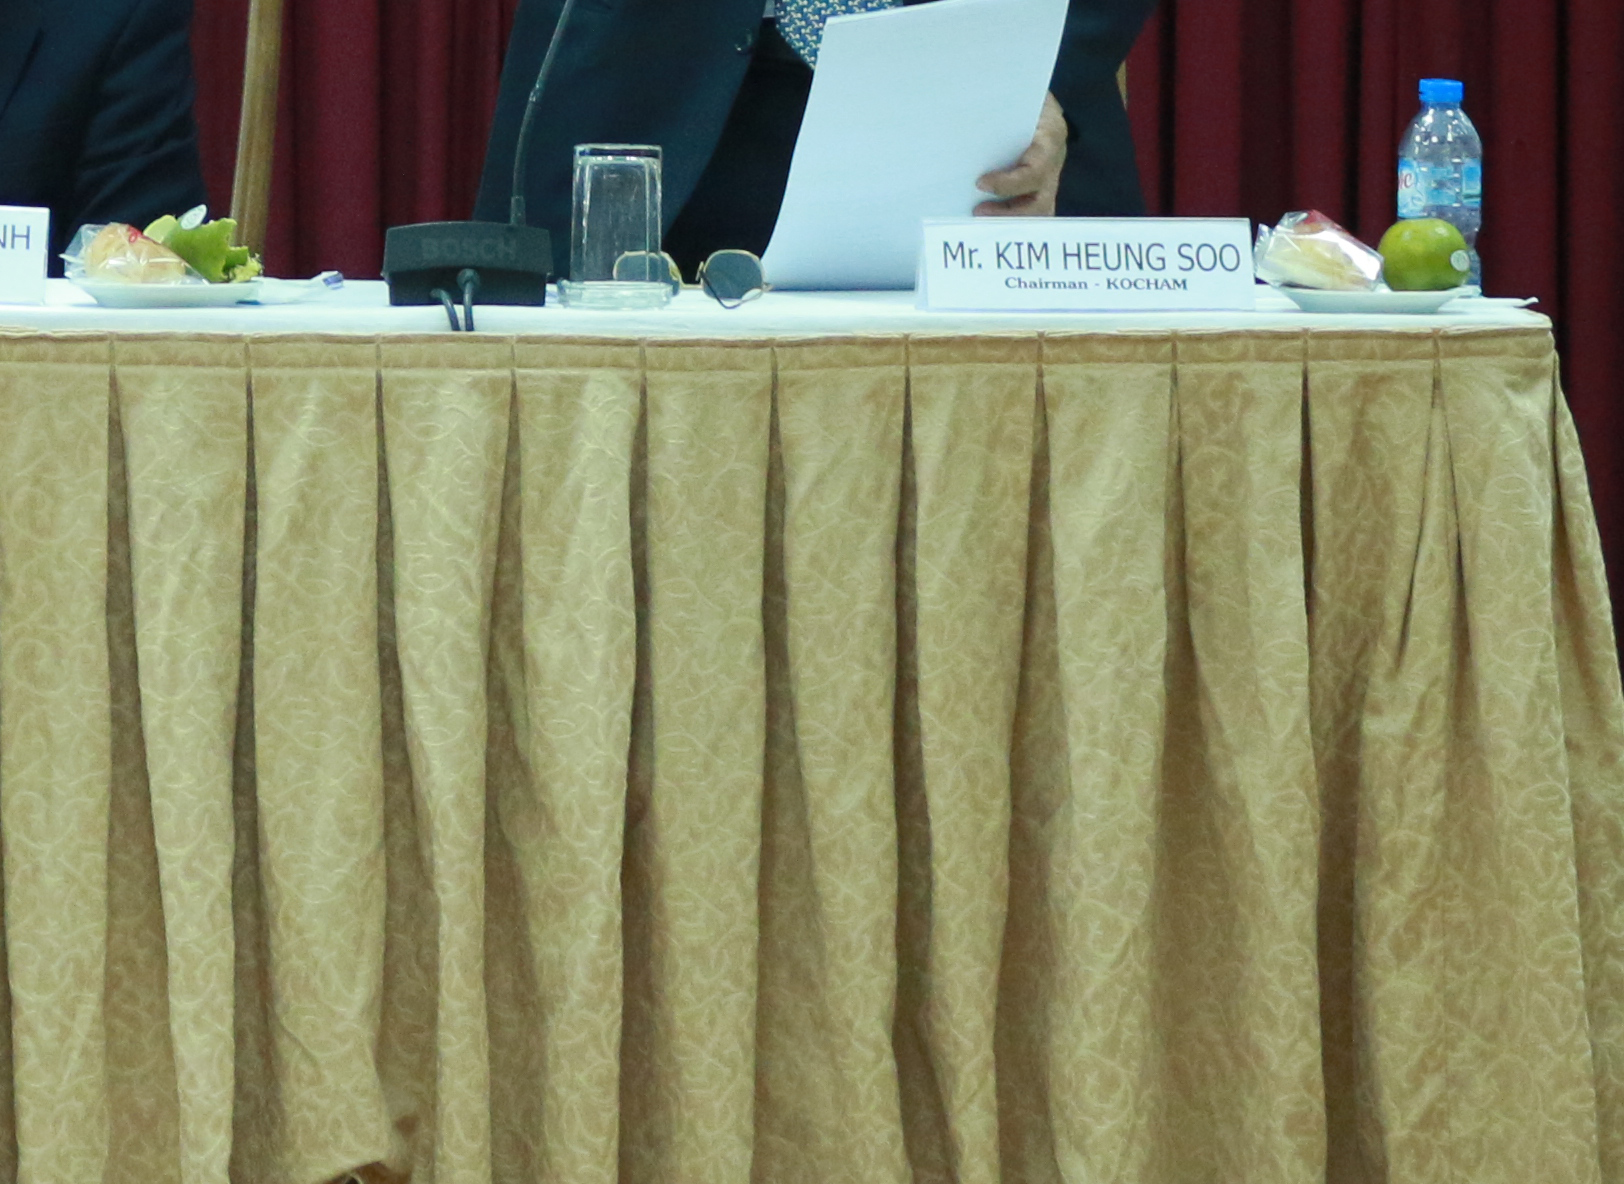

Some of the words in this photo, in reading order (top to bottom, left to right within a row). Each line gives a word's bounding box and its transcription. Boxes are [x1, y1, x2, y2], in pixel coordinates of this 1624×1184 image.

[421, 237, 516, 260] BOSCH
[943, 241, 982, 269] Mr.
[995, 241, 1050, 270] KIM
[1062, 242, 1166, 272] HEUNG
[1177, 243, 1241, 272] SOO
[1005, 276, 1088, 289] Chairman
[1106, 277, 1188, 290] KOCHAM
